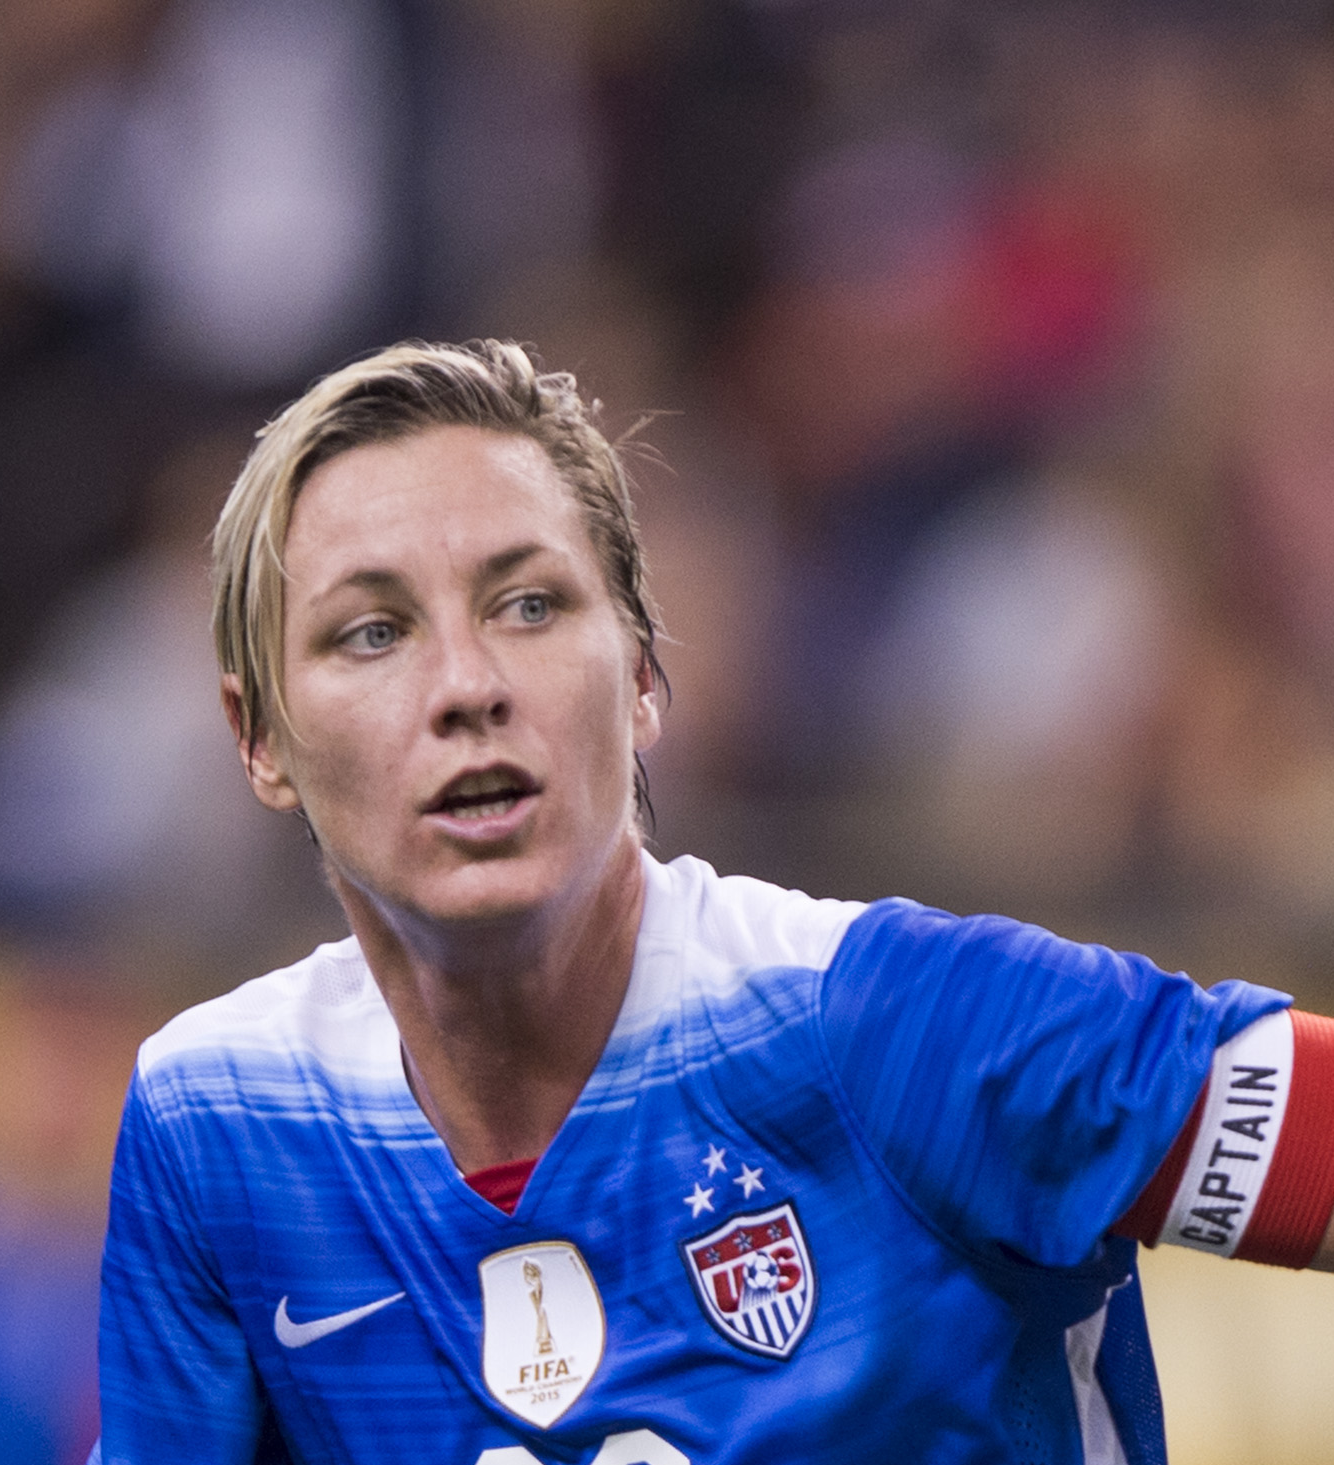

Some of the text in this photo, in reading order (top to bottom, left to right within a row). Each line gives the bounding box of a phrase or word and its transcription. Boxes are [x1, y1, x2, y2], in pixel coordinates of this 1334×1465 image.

[1179, 1064, 1279, 1246] CAPTAIN
[712, 1246, 802, 1314] US
[519, 1358, 570, 1384] FIFA
[531, 1389, 560, 1404] 2015
